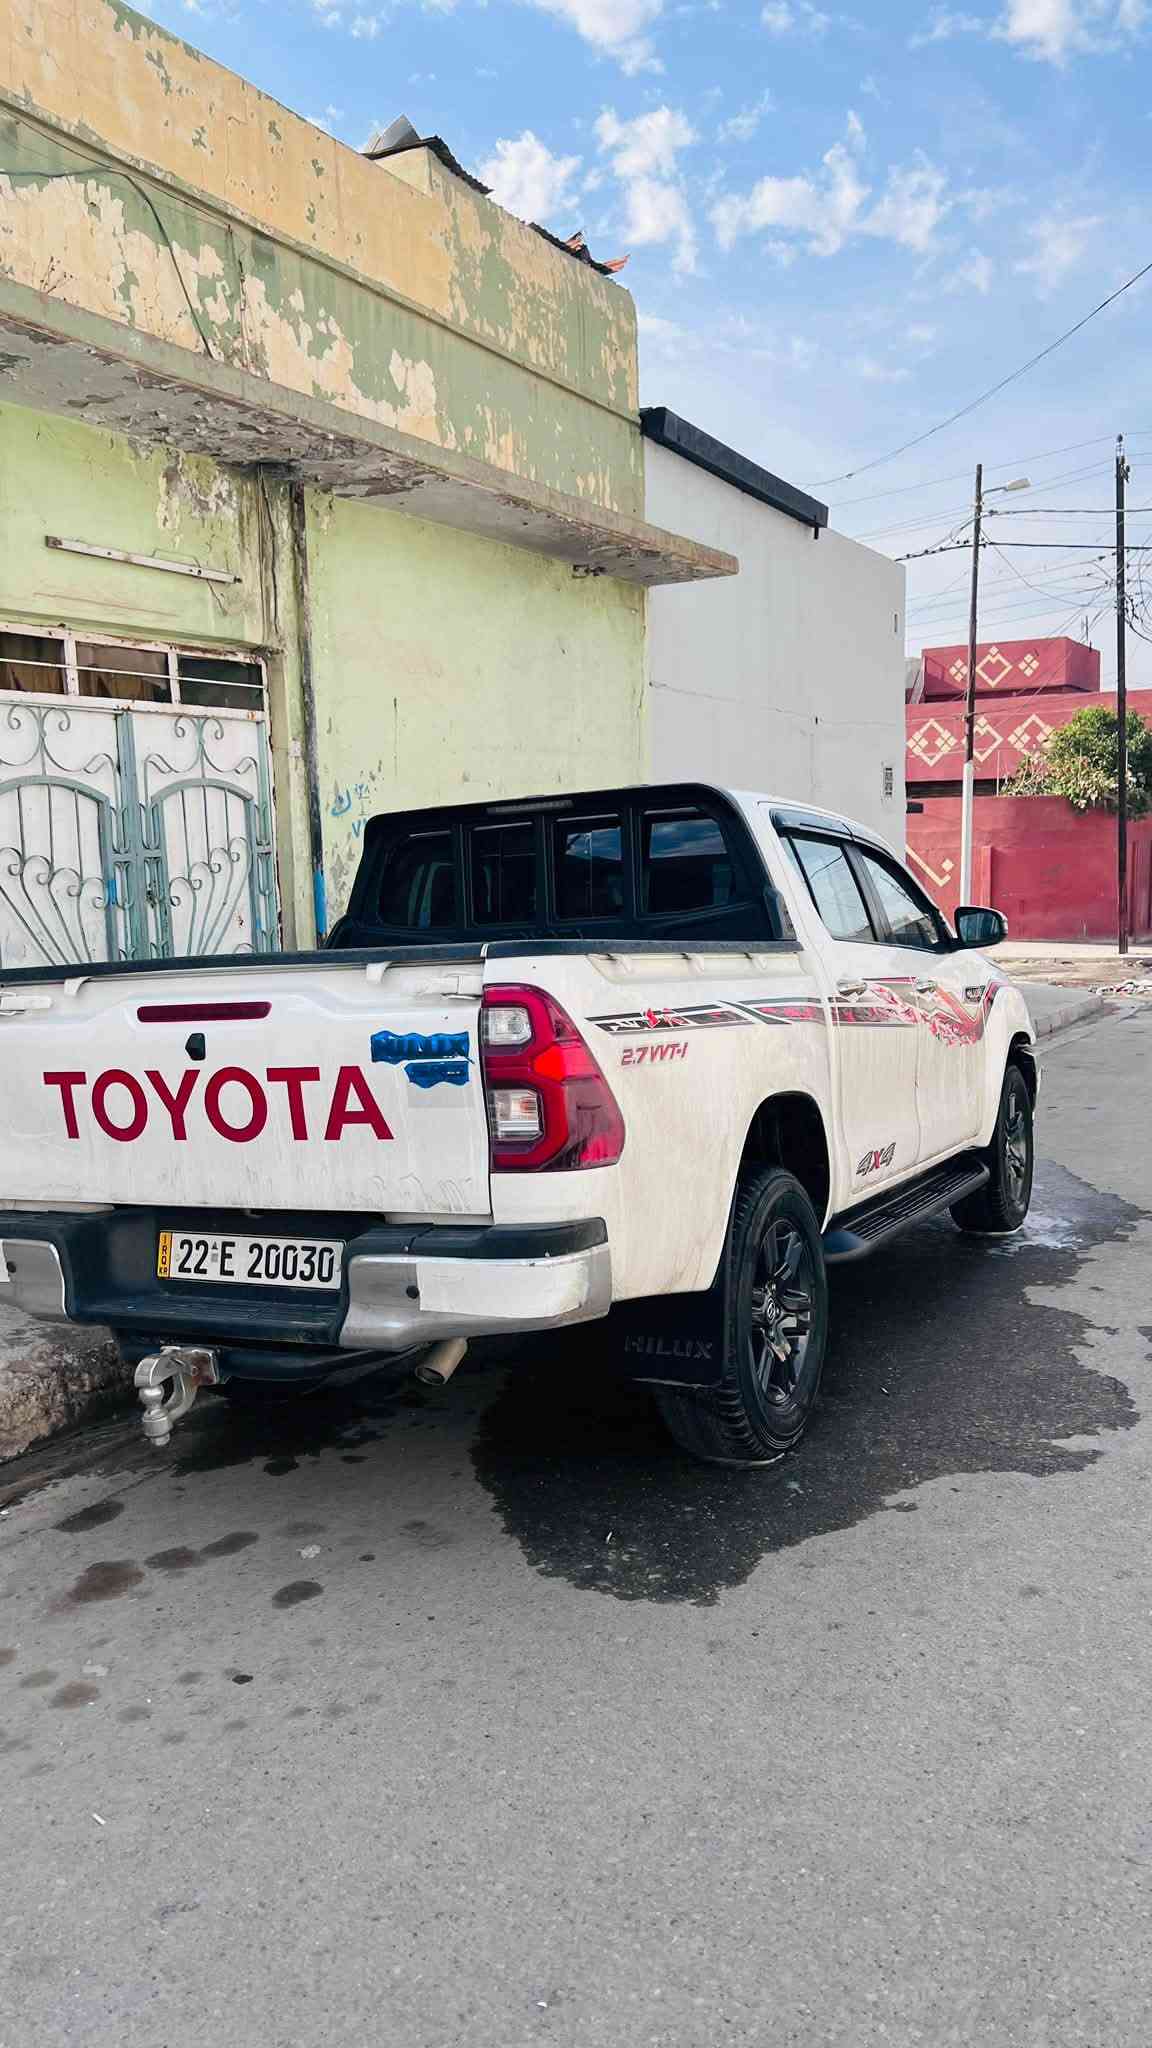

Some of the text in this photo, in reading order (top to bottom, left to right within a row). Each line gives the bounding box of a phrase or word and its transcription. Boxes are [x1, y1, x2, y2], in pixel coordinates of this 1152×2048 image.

[621, 1046, 649, 1066] 2.7
[43, 1065, 395, 1143] TOYOTA
[178, 1239, 335, 1283] 22 E 20030
[624, 1336, 712, 1360] HILUX
